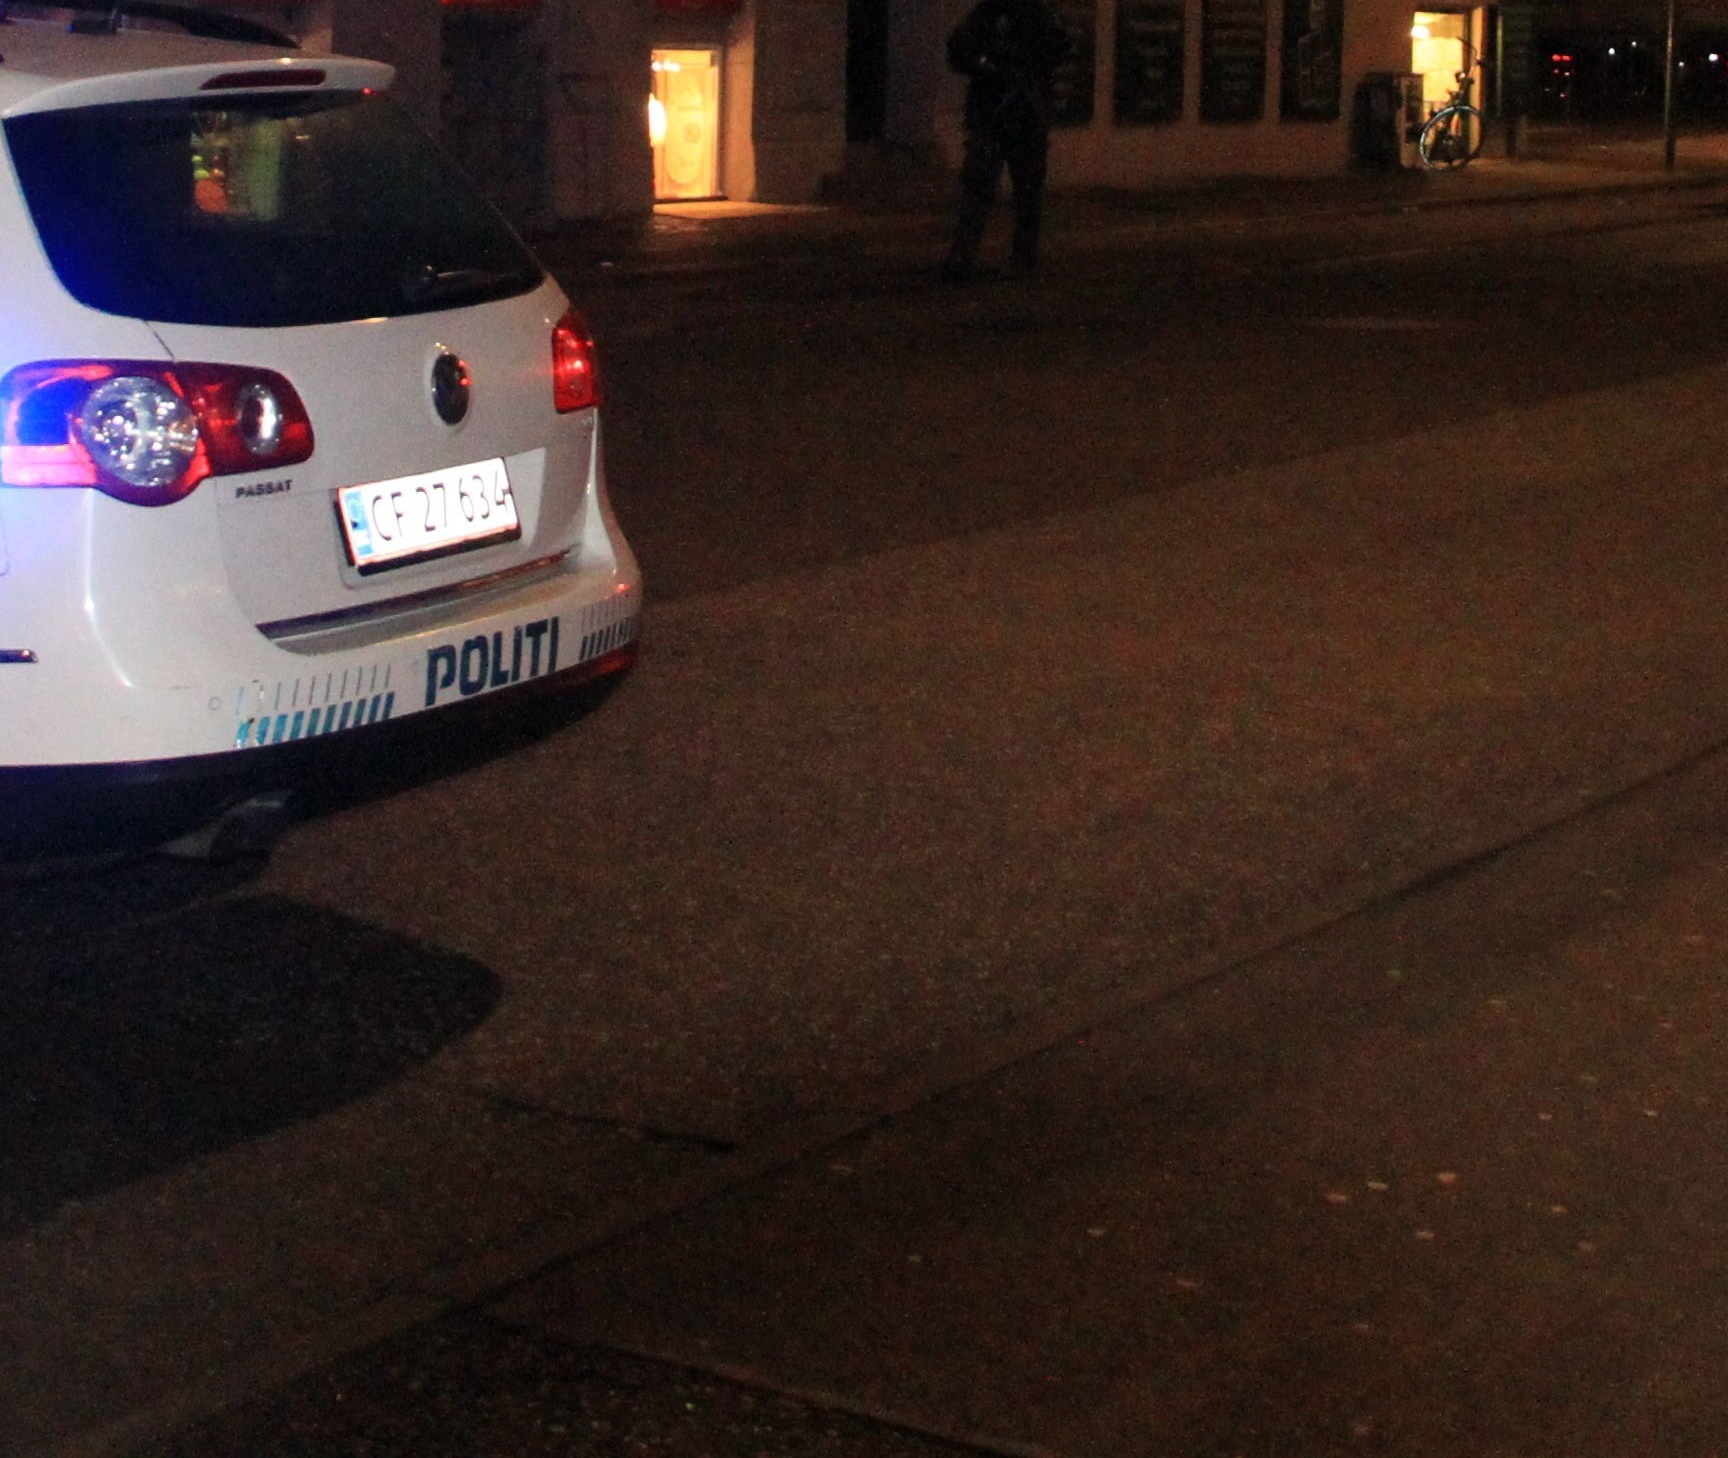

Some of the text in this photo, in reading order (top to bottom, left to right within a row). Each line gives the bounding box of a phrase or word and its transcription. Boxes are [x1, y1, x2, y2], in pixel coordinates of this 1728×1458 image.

[235, 478, 294, 499] PASSAT
[371, 470, 510, 542] CF 27 634
[426, 616, 559, 707] POLITI
